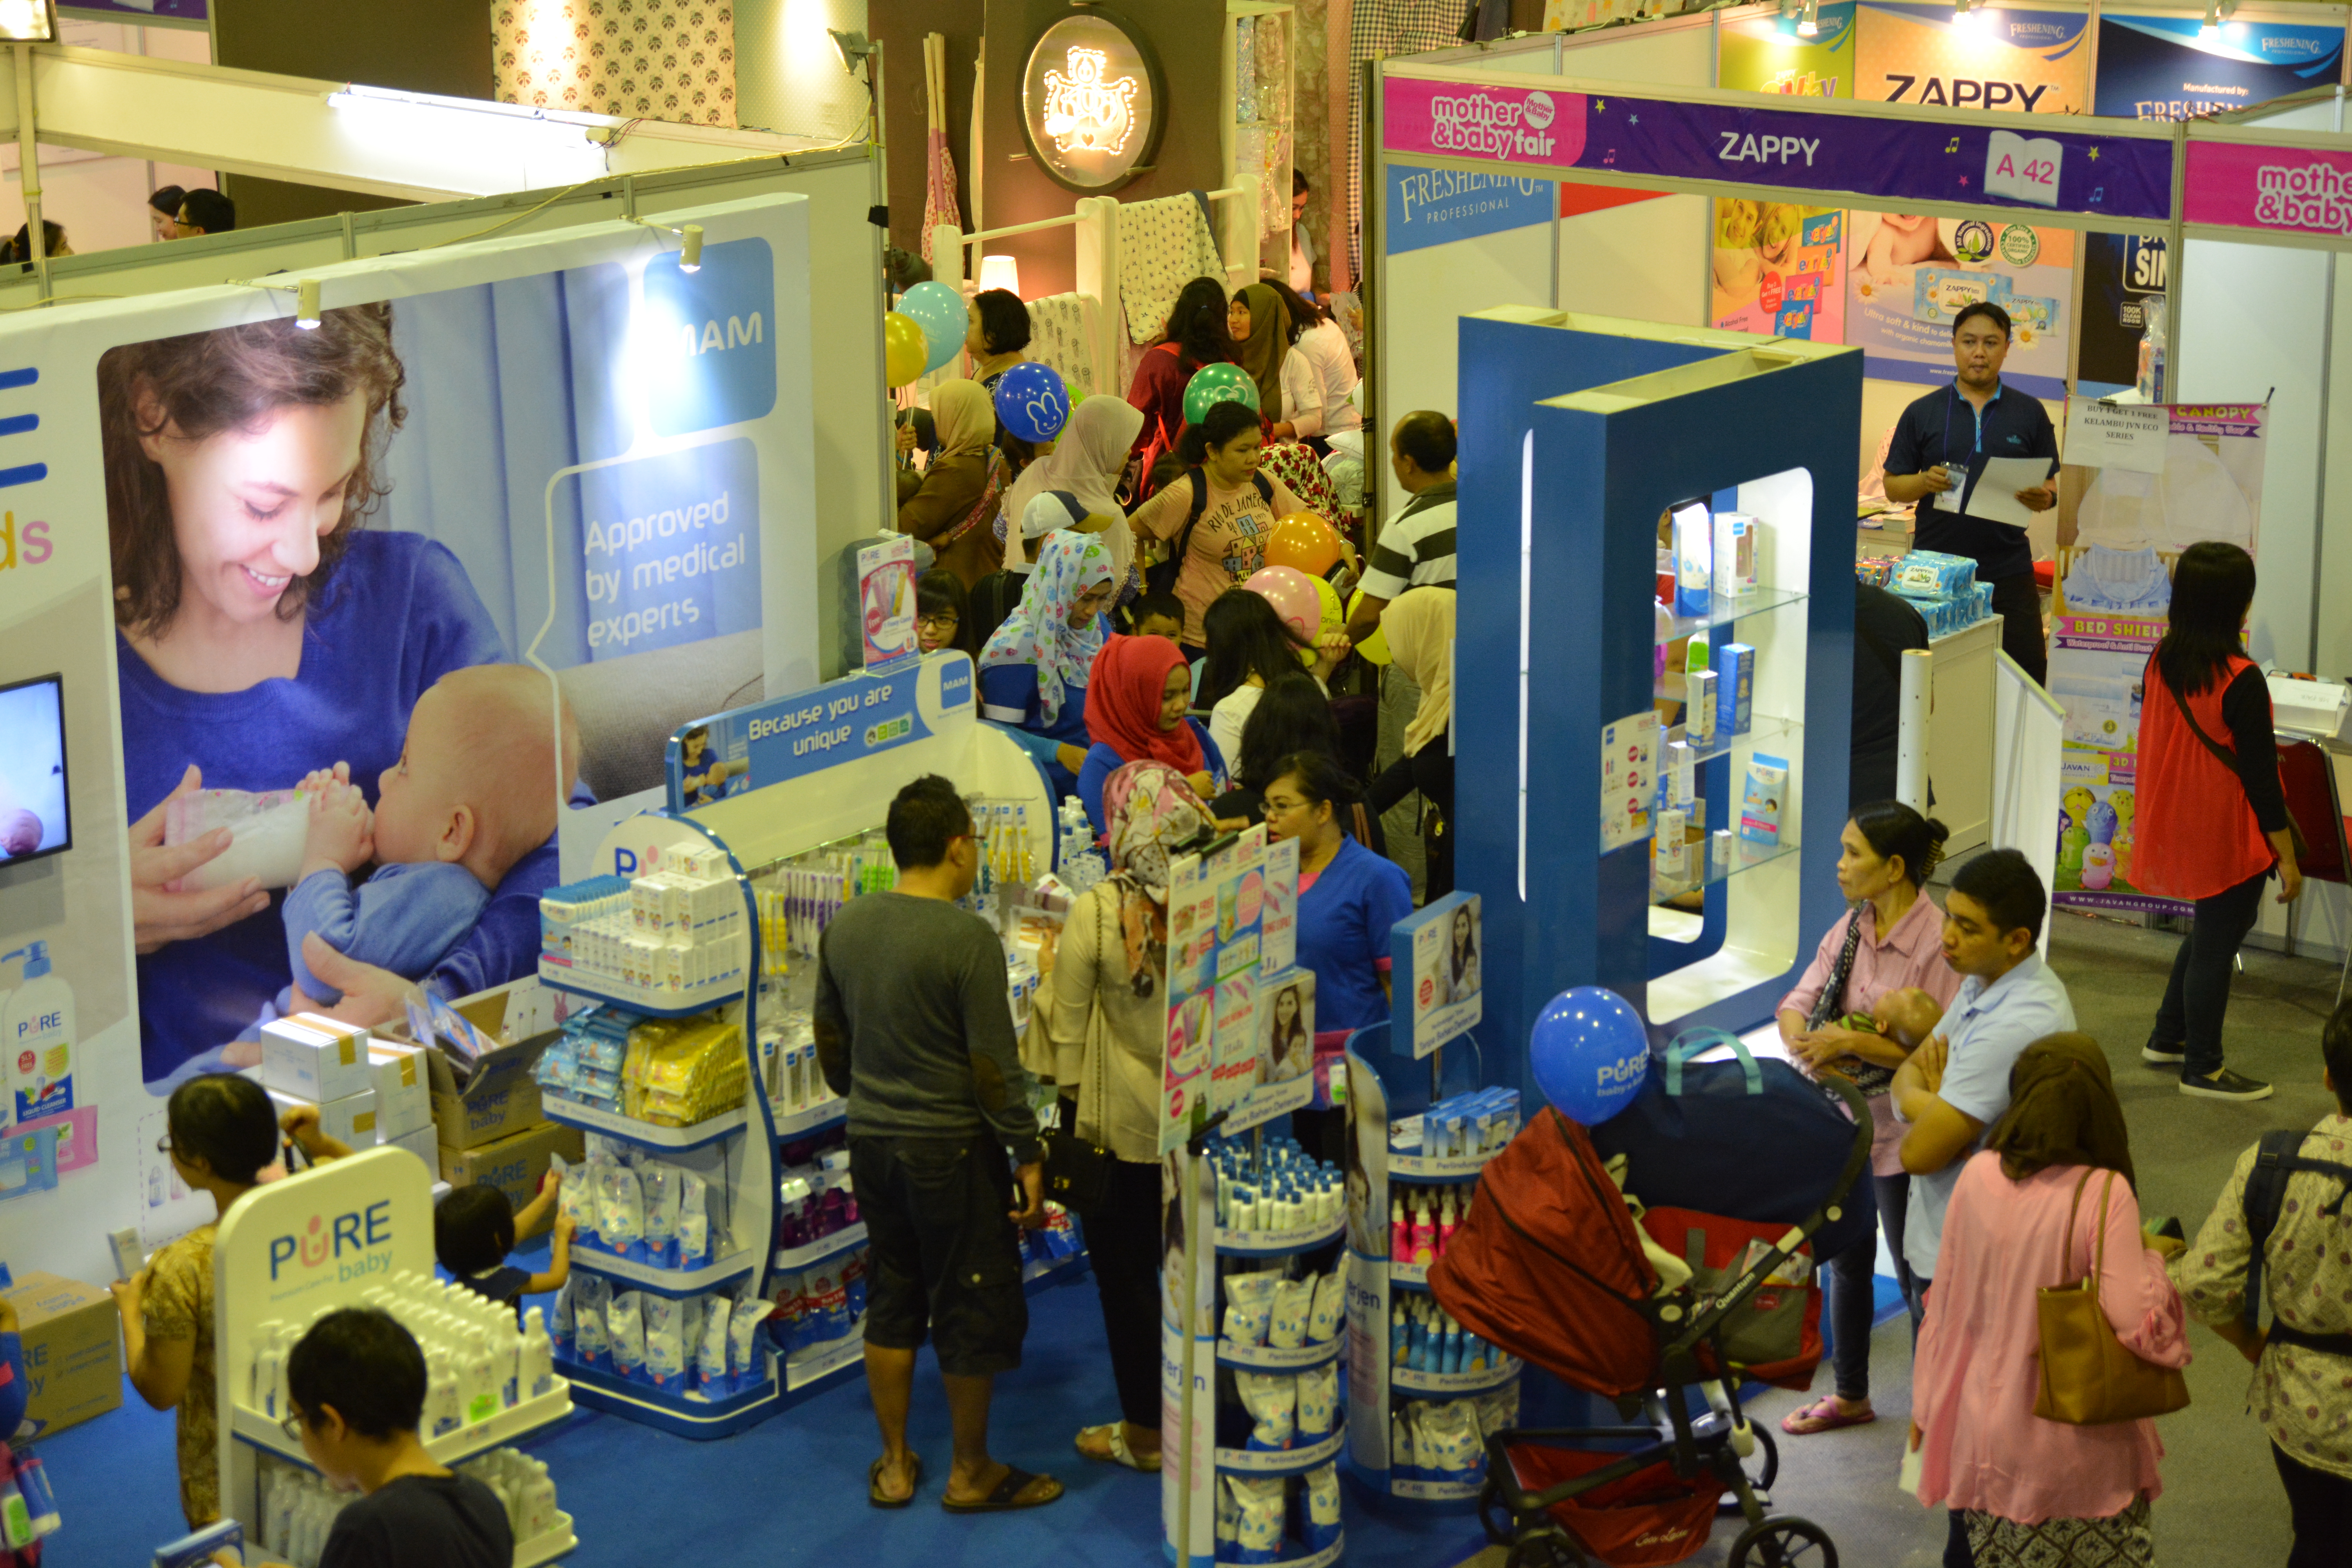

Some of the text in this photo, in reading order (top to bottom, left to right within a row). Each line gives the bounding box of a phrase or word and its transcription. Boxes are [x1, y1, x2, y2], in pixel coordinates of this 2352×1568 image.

[2011, 23, 2063, 39] FRESHENING
[2262, 37, 2319, 54] FRESHENING
[1885, 74, 2048, 112] ZAPPY
[2183, 83, 2249, 96] Manufactured by:
[1432, 93, 1523, 127] mother
[1526, 98, 1553, 114] Mother
[1432, 118, 1555, 160] &baby fair
[1719, 132, 1820, 165] ZAPPY
[1996, 154, 2054, 185] A 42
[1427, 197, 1509, 223] PROFESSIONAL
[1958, 221, 1975, 237] Natural
[1976, 221, 1993, 252] Ingredients
[1771, 287, 1782, 295] FREE
[1945, 284, 1971, 293] ZAPPY
[1725, 319, 1739, 327] Alcohol
[1864, 308, 1884, 321] Ultra
[1886, 317, 1902, 327] soft
[1903, 321, 1910, 329] &
[1912, 322, 1930, 334] kind
[1881, 328, 1894, 336] with
[1895, 333, 1918, 343] organic
[2138, 412, 2158, 420] FREE
[2176, 406, 2250, 419] CANOPY
[2084, 417, 2158, 431] KELAMBU JVN ECO
[584, 490, 729, 557] Approved
[1207, 511, 1224, 533] RIO
[586, 532, 744, 604] by medical
[588, 597, 700, 648] experts
[2074, 621, 2107, 634] BED
[2067, 639, 2110, 650] Waterproof
[2117, 642, 2133, 650] Anti
[943, 677, 968, 691] MAM
[748, 684, 892, 740] Because you are
[793, 725, 851, 756] unique
[2061, 763, 2090, 771] JAVAN
[2112, 757, 2129, 767] 3D
[2069, 896, 2194, 913] WWW.JAVANGROUP.COM
[18, 1011, 62, 1038] PURE
[21, 1053, 33, 1062] SLS
[1597, 1051, 1647, 1086] PURE
[23, 1105, 40, 1117] LIQUID
[41, 1098, 66, 1110] CLEANSER
[467, 1090, 510, 1114] PURE
[471, 1111, 505, 1130] baby
[270, 1199, 392, 1281] PURE
[339, 1250, 392, 1283] baby
[1715, 1272, 1756, 1309] Quantum
